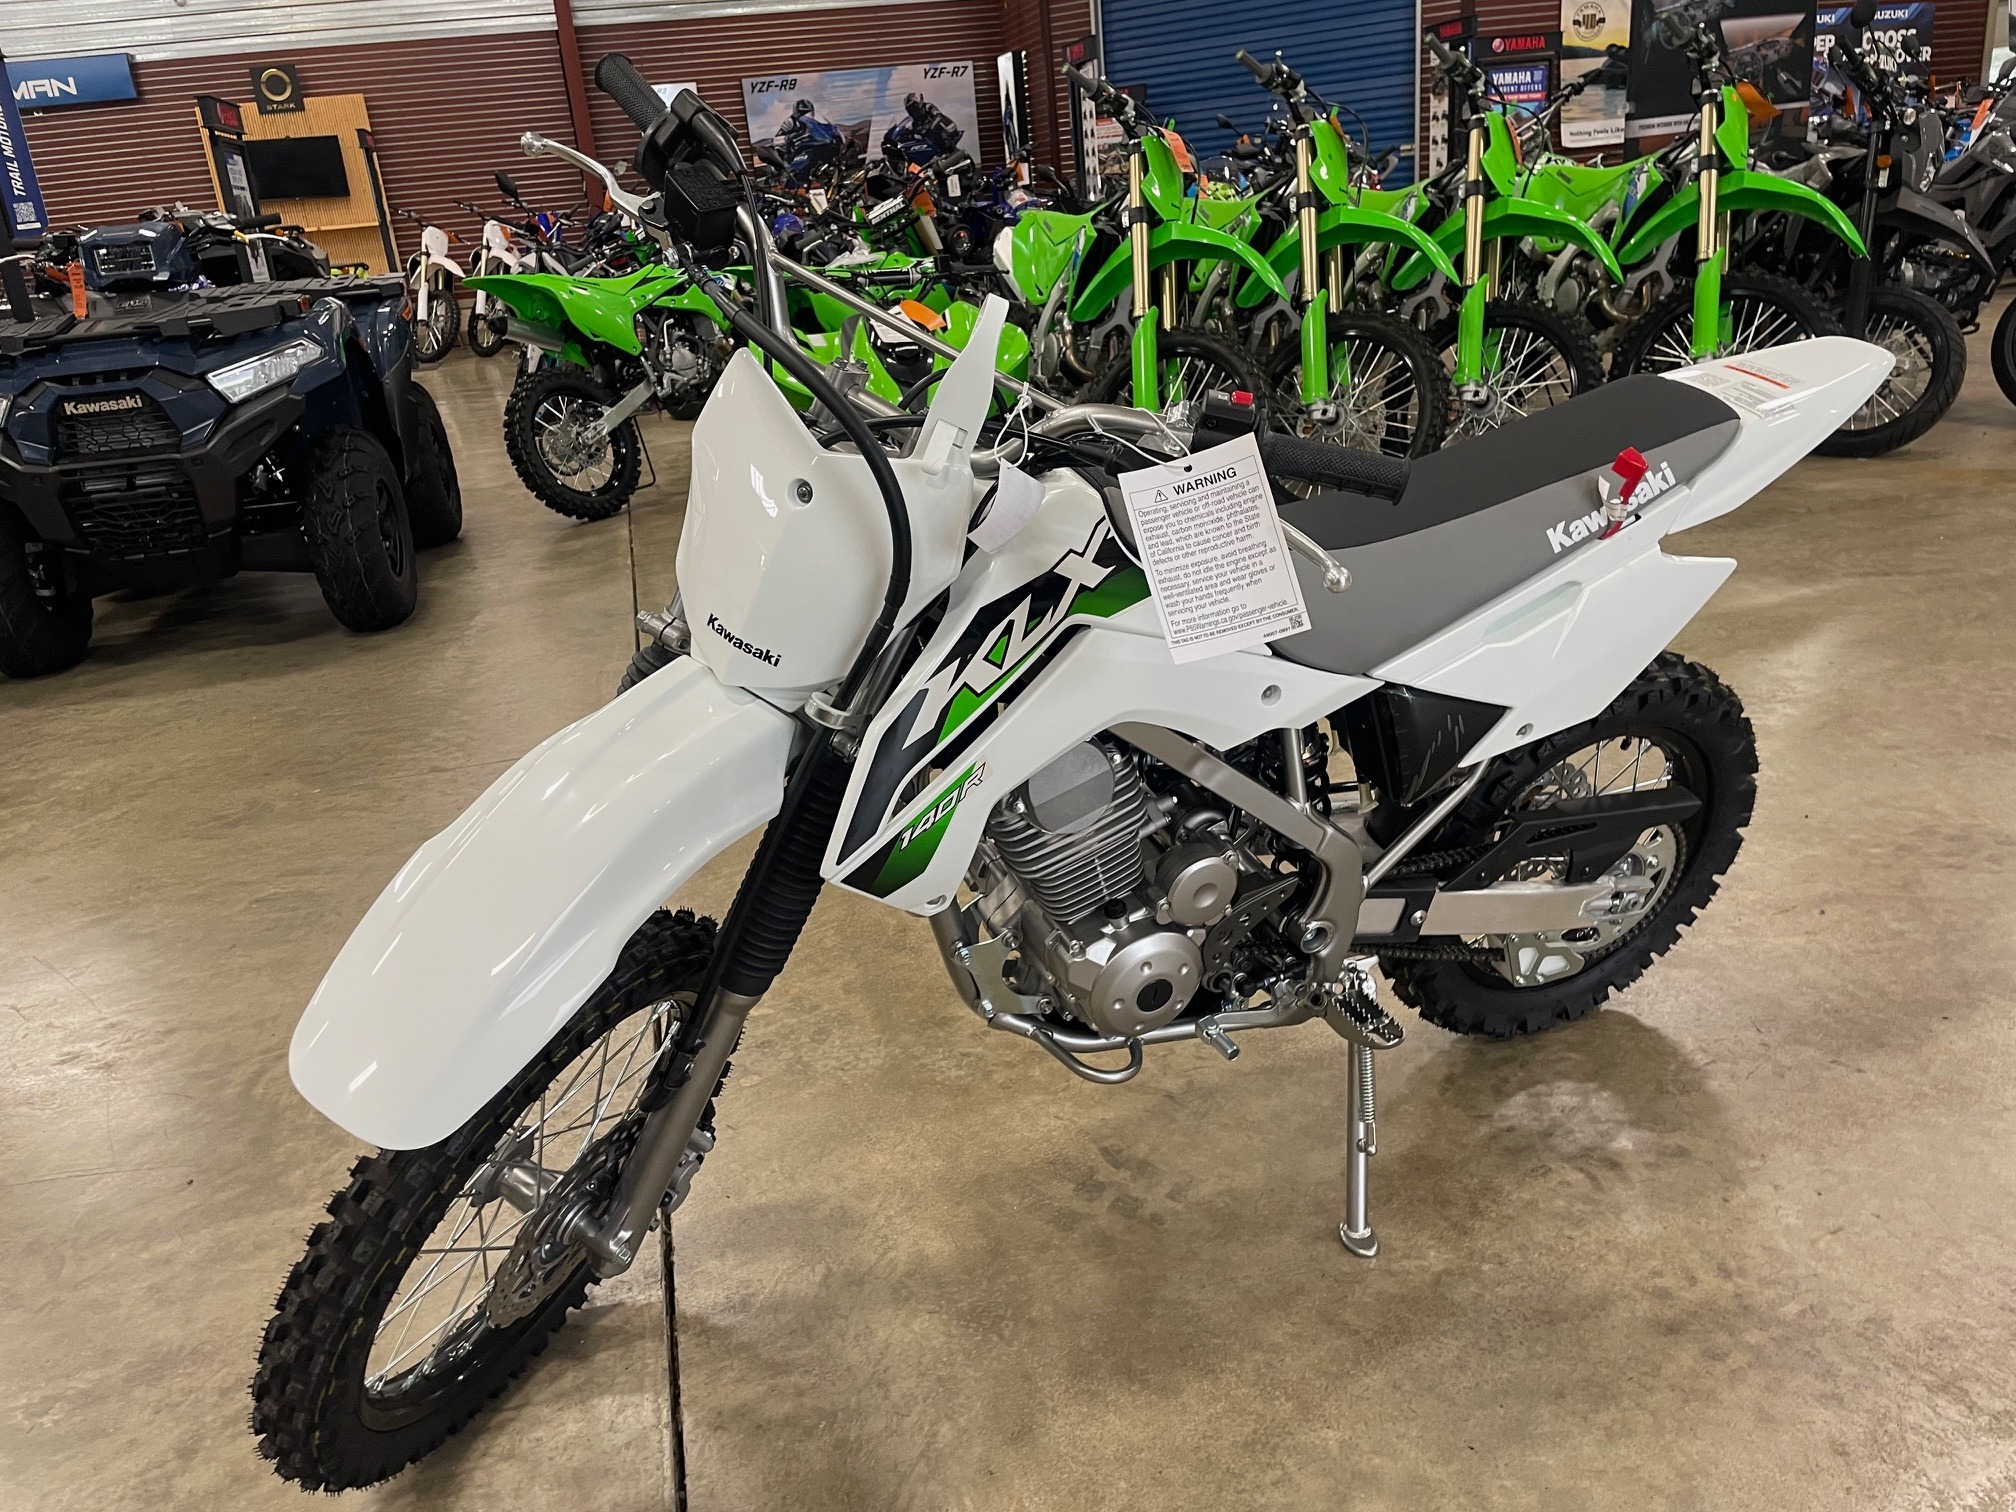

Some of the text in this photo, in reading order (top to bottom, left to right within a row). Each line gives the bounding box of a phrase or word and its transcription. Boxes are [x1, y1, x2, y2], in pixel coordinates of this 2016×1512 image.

[1504, 36, 1546, 52] YAMAHA
[750, 78, 798, 94] YZF-R9
[923, 65, 969, 80] YZF-R7
[1492, 71, 1531, 86] YAMAHA
[266, 102, 297, 111] STARK
[5, 160, 27, 196] TRAIL
[63, 394, 143, 416] Kawasaki
[1169, 498, 1197, 511] servicing
[1197, 492, 1210, 503] and
[1210, 481, 1246, 498] maintaining
[1172, 467, 1237, 496] WARNING
[1140, 512, 1171, 528] passenger
[1171, 507, 1194, 518] vehicle
[1201, 496, 1226, 510] off-road
[1225, 489, 1248, 502] vehicle
[1248, 485, 1260, 494] can
[1142, 524, 1164, 536] expose
[1164, 521, 1176, 533] you
[1183, 510, 1215, 524] chemicals
[1215, 500, 1243, 514] including
[1242, 493, 1263, 506] engine
[1148, 542, 1160, 550] and
[1175, 533, 1193, 543] which
[1193, 530, 1204, 539] are
[1204, 524, 1226, 535] known
[1232, 518, 1244, 526] the
[1243, 512, 1260, 523] State
[1156, 545, 1185, 557] California
[1192, 537, 1211, 548] cause
[1212, 530, 1233, 542] cancer
[1234, 525, 1246, 535] and
[1246, 521, 1261, 531] birth
[1171, 525, 1193, 536] carbon
[1152, 556, 1174, 567] defects
[1181, 550, 1197, 559] other
[1198, 539, 1236, 555] reproductive
[1163, 563, 1190, 575] minimize
[1220, 549, 1238, 560] avoid
[1237, 540, 1268, 555] breathing
[1191, 568, 1203, 576] not
[1203, 566, 1214, 574] idle
[1214, 562, 1225, 570] the
[1225, 556, 1247, 568] engine
[1247, 548, 1269, 561] except
[1162, 585, 1204, 600] well-ventilated
[1204, 582, 1219, 591] area
[1219, 577, 1232, 587] and
[1231, 573, 1247, 583] wear
[1248, 567, 1268, 580] gloves
[1192, 574, 1214, 586] service
[1214, 570, 1228, 581] your
[1228, 563, 1251, 575] vehicle
[1164, 577, 1263, 609] wash your hands frequently when
[1167, 606, 1194, 617] servicing
[1193, 602, 1207, 613] your
[1170, 620, 1181, 628] For
[1181, 616, 1197, 625] more
[1197, 608, 1231, 621] information
[706, 613, 782, 668] Kawasaki
[901, 515, 1117, 751] KLX
[899, 761, 988, 852] 140R
